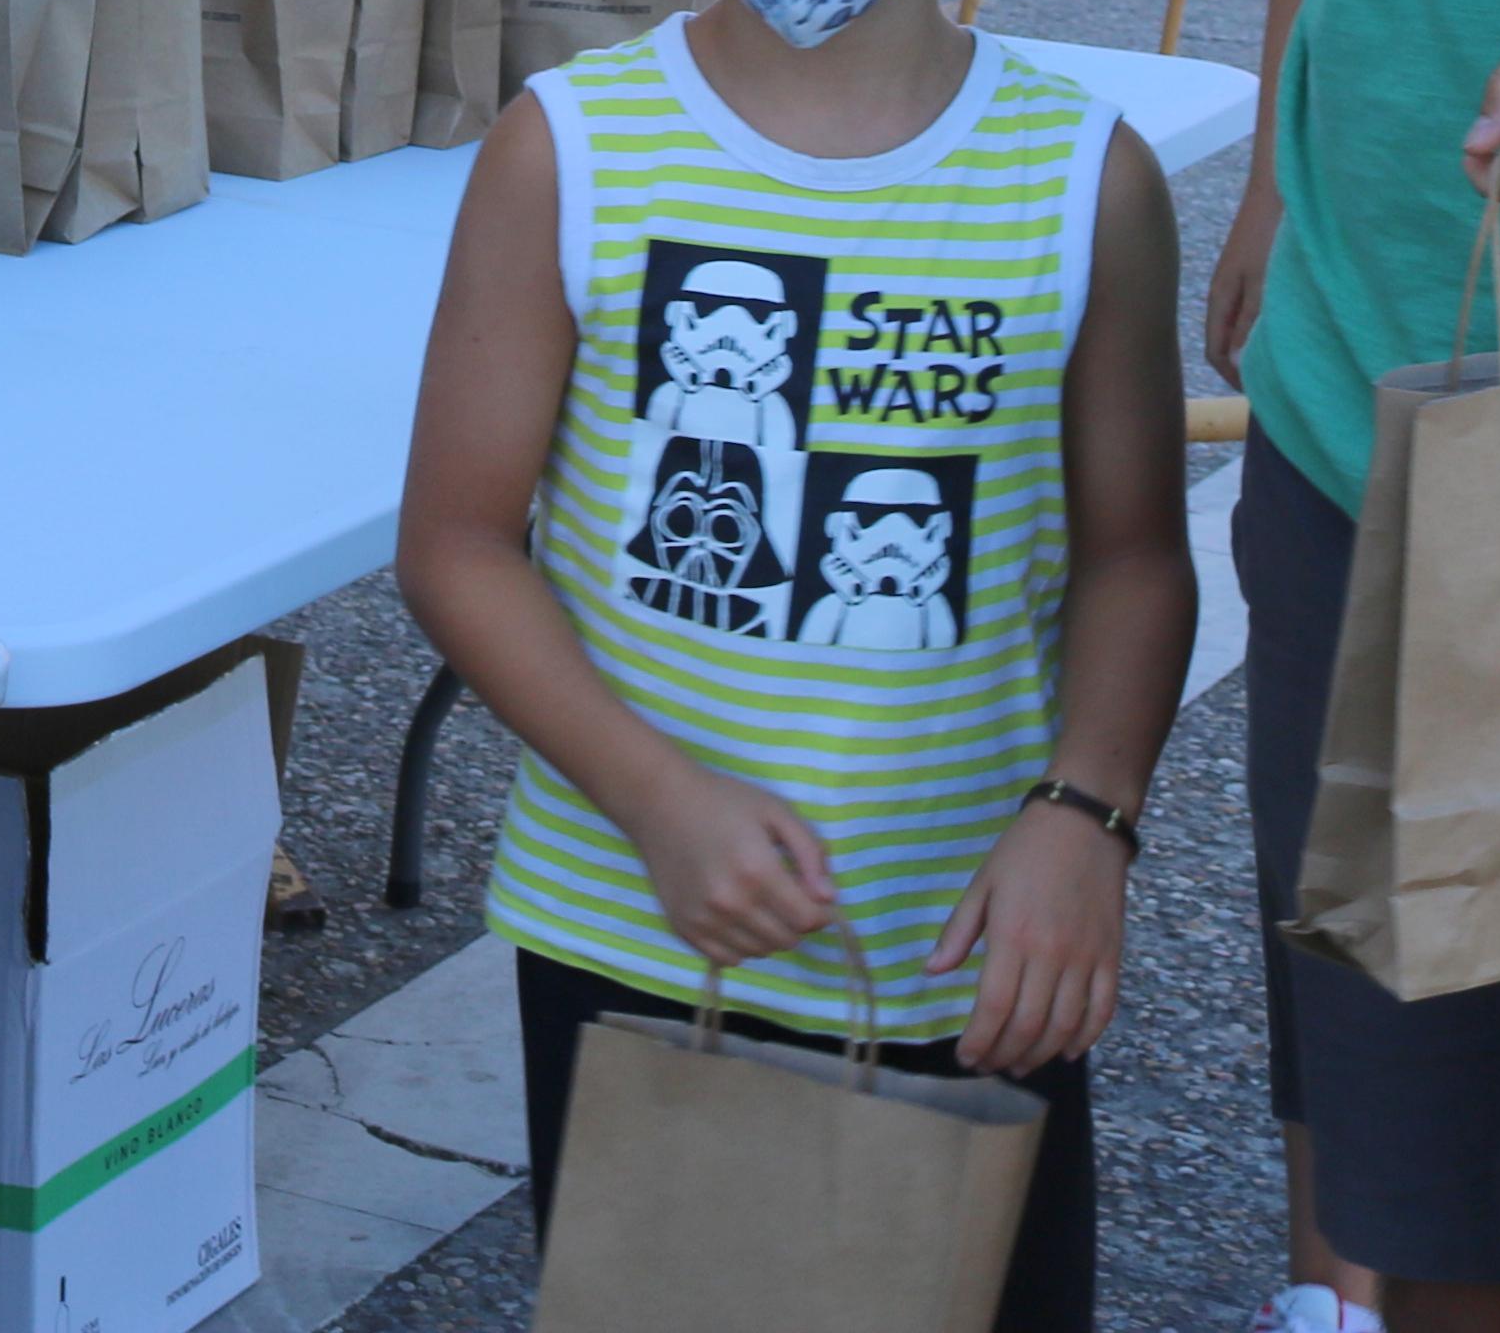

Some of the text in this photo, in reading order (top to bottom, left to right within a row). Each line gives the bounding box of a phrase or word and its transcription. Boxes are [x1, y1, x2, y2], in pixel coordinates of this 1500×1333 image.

[846, 290, 1003, 361] STAR
[829, 362, 1005, 424] WARS
[103, 1097, 204, 1171] VINO BLANCO
